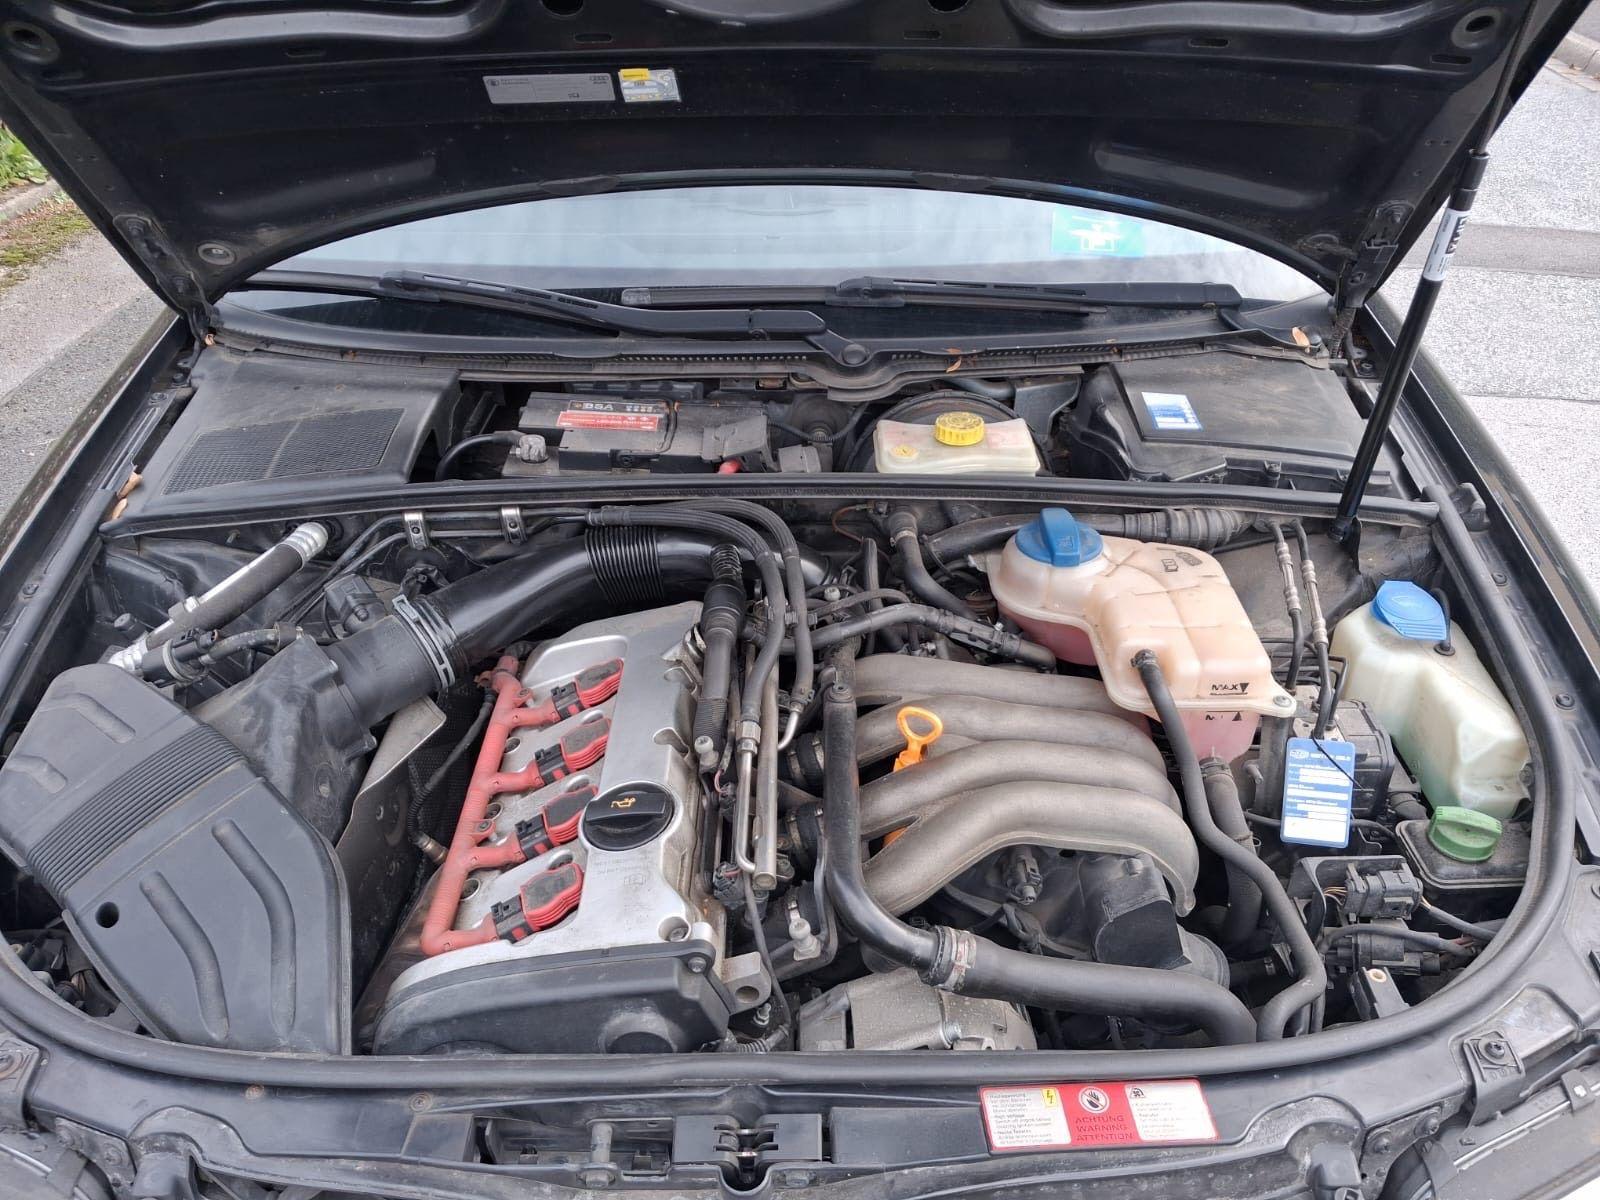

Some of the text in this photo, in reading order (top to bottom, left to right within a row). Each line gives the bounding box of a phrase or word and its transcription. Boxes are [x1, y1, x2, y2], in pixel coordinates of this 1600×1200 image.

[584, 402, 613, 411] BSA
[1075, 1115, 1125, 1124] ACHTUNG
[1076, 1124, 1128, 1132] WARNING
[1076, 1132, 1133, 1141] ATTENTION
